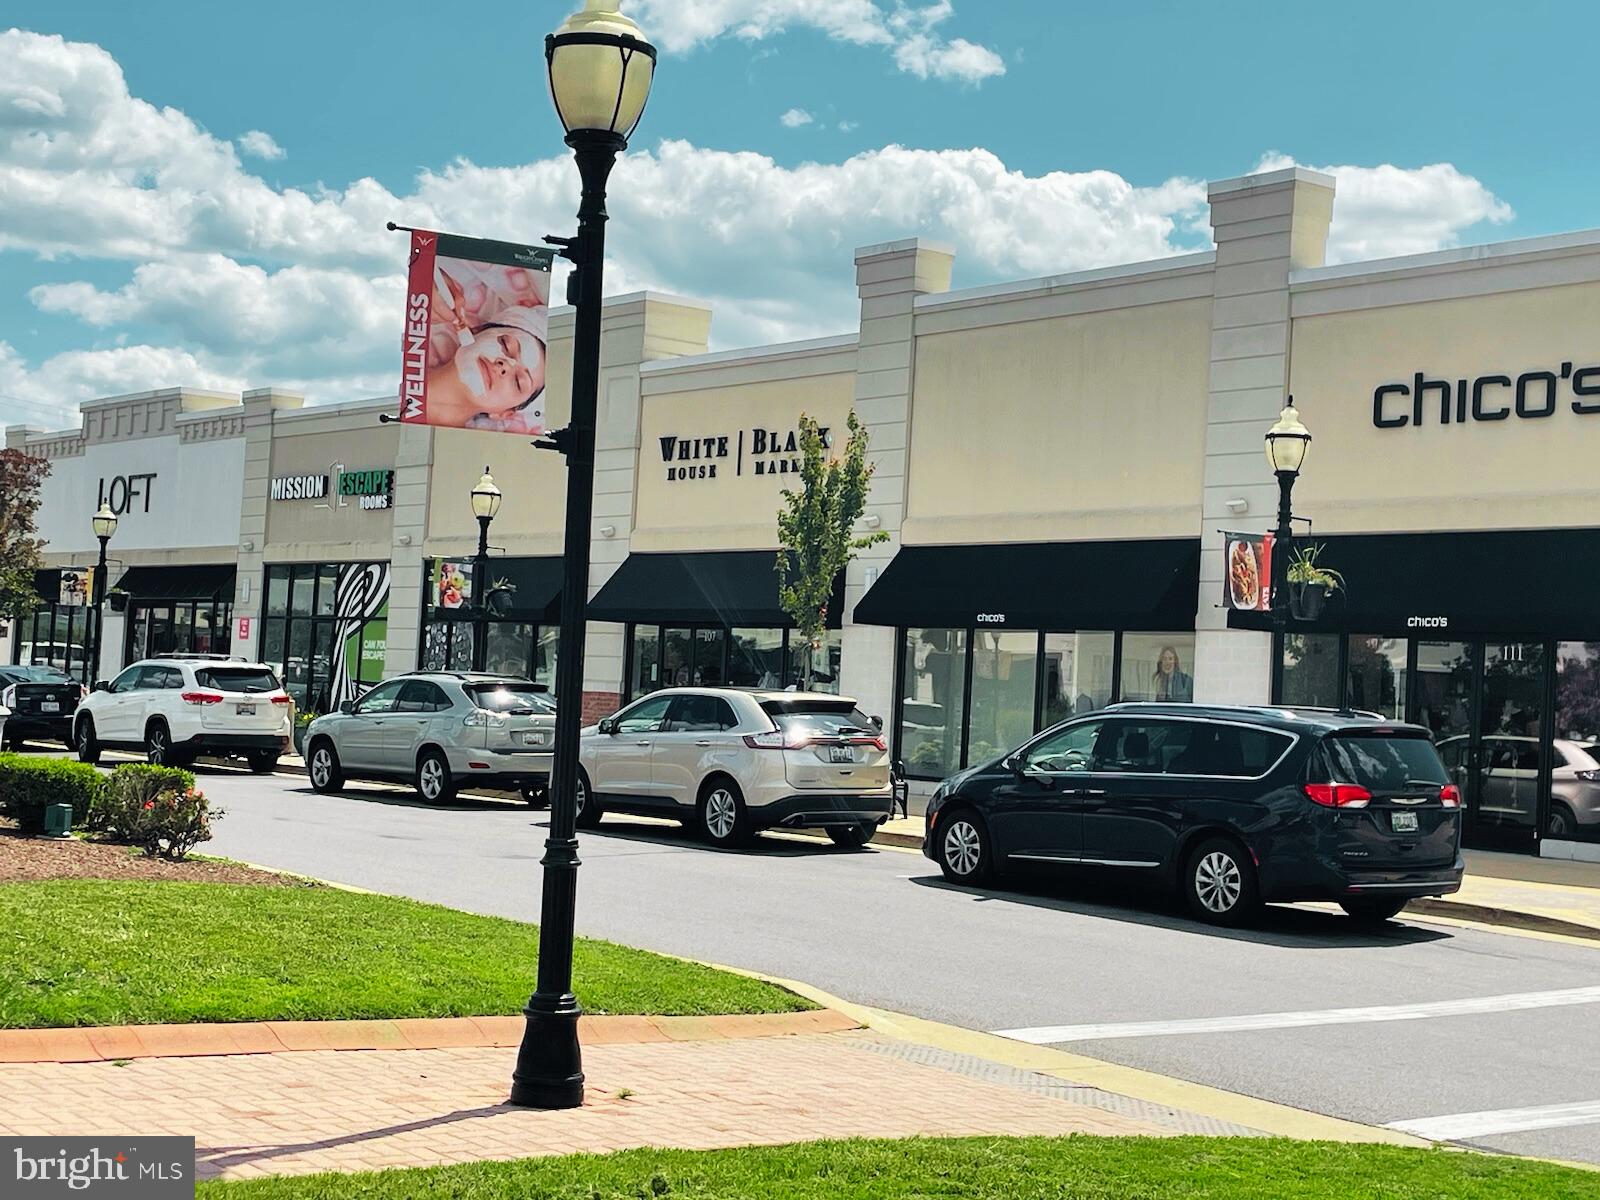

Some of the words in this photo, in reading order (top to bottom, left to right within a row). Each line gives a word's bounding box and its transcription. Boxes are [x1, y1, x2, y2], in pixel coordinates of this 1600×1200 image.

[405, 294, 429, 418] WELLNESS
[1373, 362, 1600, 428] chico's
[659, 436, 729, 462] WHITE
[667, 465, 717, 481] HOUSE
[97, 473, 158, 516] LOFT
[270, 475, 326, 500] MISSION
[339, 470, 391, 495] ESCAPE
[359, 495, 389, 510] ROOMS
[976, 613, 1006, 623] chico's
[1406, 615, 1448, 628] chico's
[1503, 643, 1522, 661] 111
